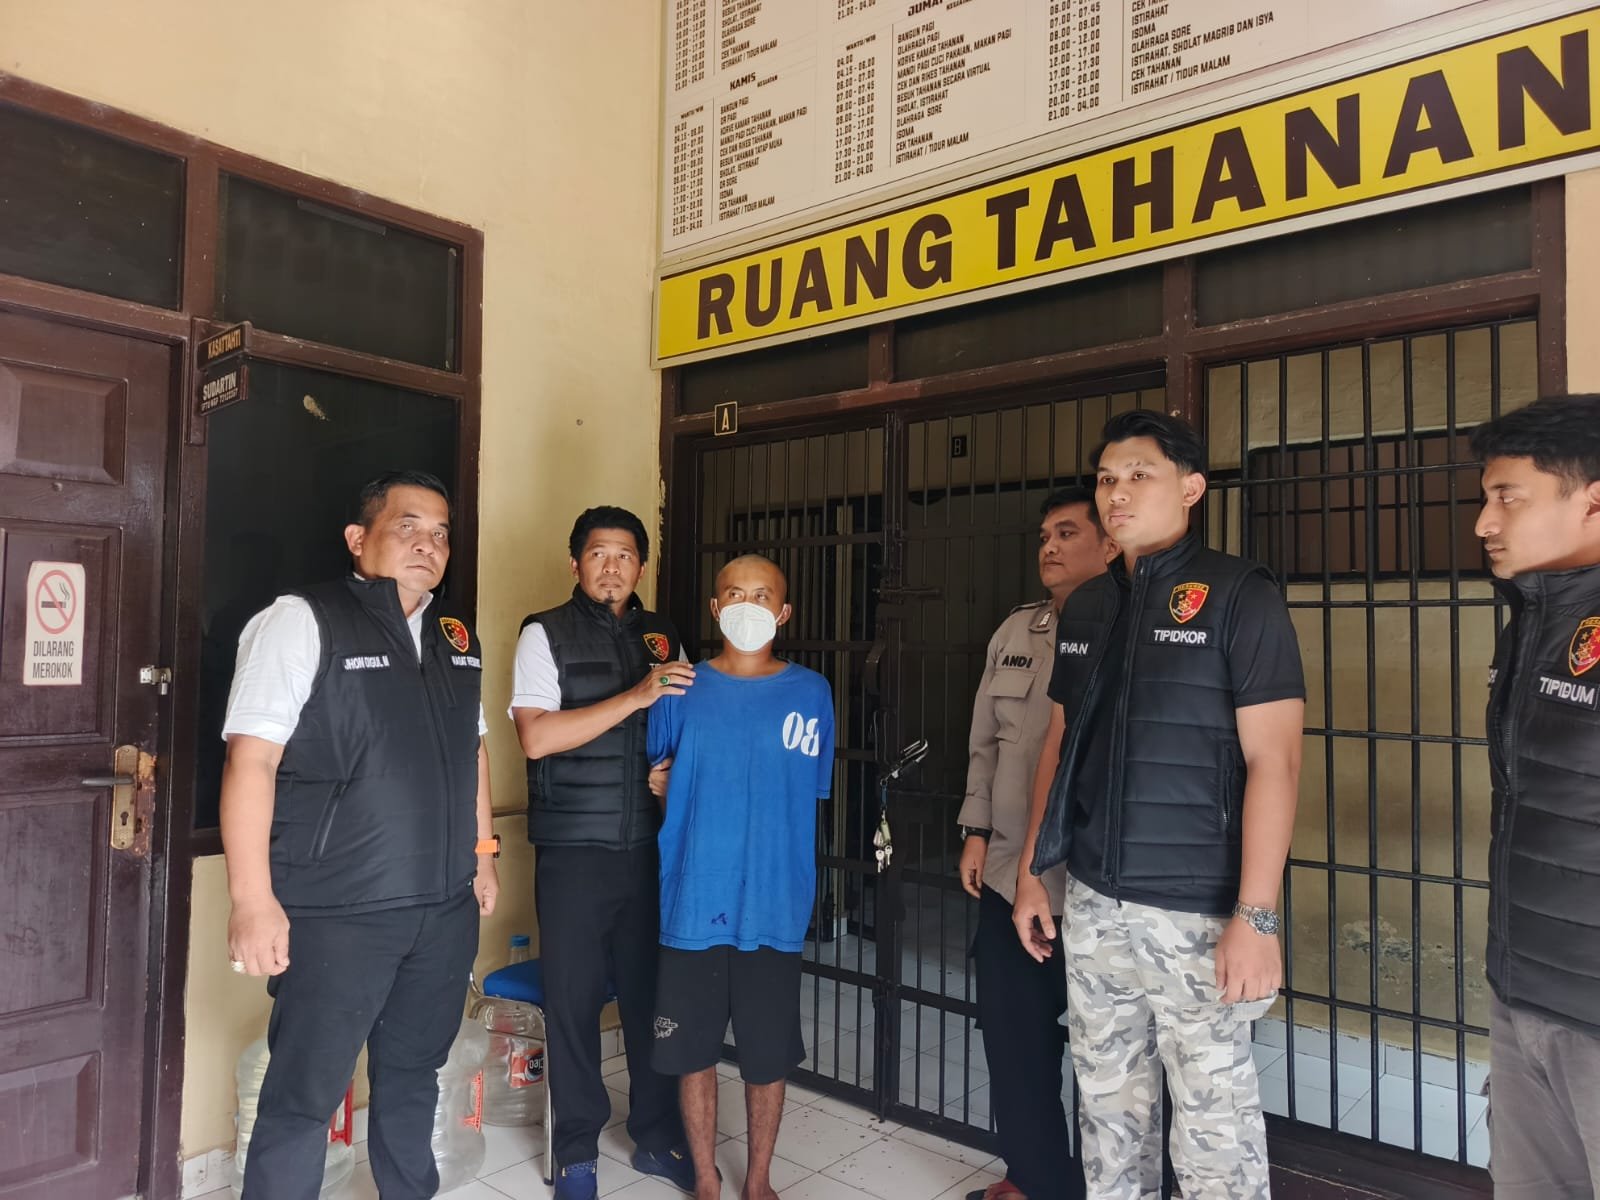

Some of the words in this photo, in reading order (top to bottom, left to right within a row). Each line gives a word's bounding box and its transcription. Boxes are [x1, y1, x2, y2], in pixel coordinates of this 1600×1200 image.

[1050, 11, 1070, 30] 07.00
[1078, 0, 1100, 18] 07.45
[1131, 2, 1168, 27] ISTIRAHAT
[1132, 0, 1145, 12] CEK
[898, 26, 920, 43] BANGUN
[922, 21, 934, 34] PAGI
[1078, 12, 1100, 31] 09.00
[1131, 21, 1156, 40] ISOMA
[1172, 34, 1201, 54] SHOLAT
[1203, 23, 1234, 44] MAGRIB
[1236, 17, 1253, 34] DAN
[1255, 10, 1274, 28] ISYA
[897, 37, 925, 55] OLAHRAGA
[927, 31, 939, 44] PAGI
[916, 45, 935, 60] KAMAR
[937, 34, 964, 52] TAHANAN
[1078, 26, 1100, 45] 12.00
[1131, 31, 1169, 54] OLAHRAGA
[1171, 23, 1191, 40] SORE
[897, 64, 915, 79] MANDI
[917, 59, 930, 72] PAGI
[931, 53, 944, 67] CUCI
[974, 35, 995, 51] MAKAN
[998, 29, 1011, 43] PAGI
[1049, 52, 1070, 68] 12.00
[1078, 40, 1100, 58] 17.00
[897, 79, 907, 91] CEK
[909, 75, 919, 87] DAN
[921, 68, 937, 82] RIKES
[938, 58, 965, 76] TAHANAN
[1049, 65, 1070, 82] 17.00
[1078, 54, 1100, 72] 17.30
[1131, 67, 1145, 81] CEK
[1147, 55, 1181, 76] TAHANAN
[1131, 74, 1168, 96] ISTIRAHAT
[1175, 64, 1198, 83] TIDUR
[1200, 55, 1230, 75] MALAM
[729, 71, 755, 90] KAMIS
[896, 89, 914, 103] BESUK
[916, 79, 941, 96] TAHANAN
[943, 71, 965, 87] SECARA
[966, 62, 990, 79] VIRTUAL
[1048, 79, 1069, 95] 17.30
[1077, 69, 1100, 85] 20.00
[920, 89, 948, 107] ISTIRAHAT
[1048, 92, 1069, 108] 20.00
[1077, 82, 1099, 99] 21.00
[896, 110, 925, 127] OLAHRAGA
[927, 104, 942, 117] SORE
[1048, 105, 1069, 121] 21.00
[1077, 96, 1099, 112] 04.00
[752, 131, 772, 145] TAHANAN
[896, 126, 914, 139] ISOMA
[896, 140, 907, 152] CEK
[908, 131, 932, 147] TAHANAN
[734, 148, 753, 162] TAHANAN
[895, 147, 923, 164] ISTIRAHAT
[929, 139, 946, 153] TIDUR
[947, 132, 968, 147] MALAM
[696, 214, 953, 340] RUANG
[986, 29, 1591, 271] TAHANAN
[730, 194, 747, 206] TAHANAN
[758, 196, 774, 208] MALAM
[722, 408, 729, 431] A
[33, 641, 74, 656] DILARANG
[1154, 630, 1208, 645] TIPIDKOR
[32, 662, 73, 679] MEROKOK
[1002, 654, 1033, 668] ANDI
[1540, 676, 1596, 704] TIPIDUM
[782, 712, 819, 756] 08
